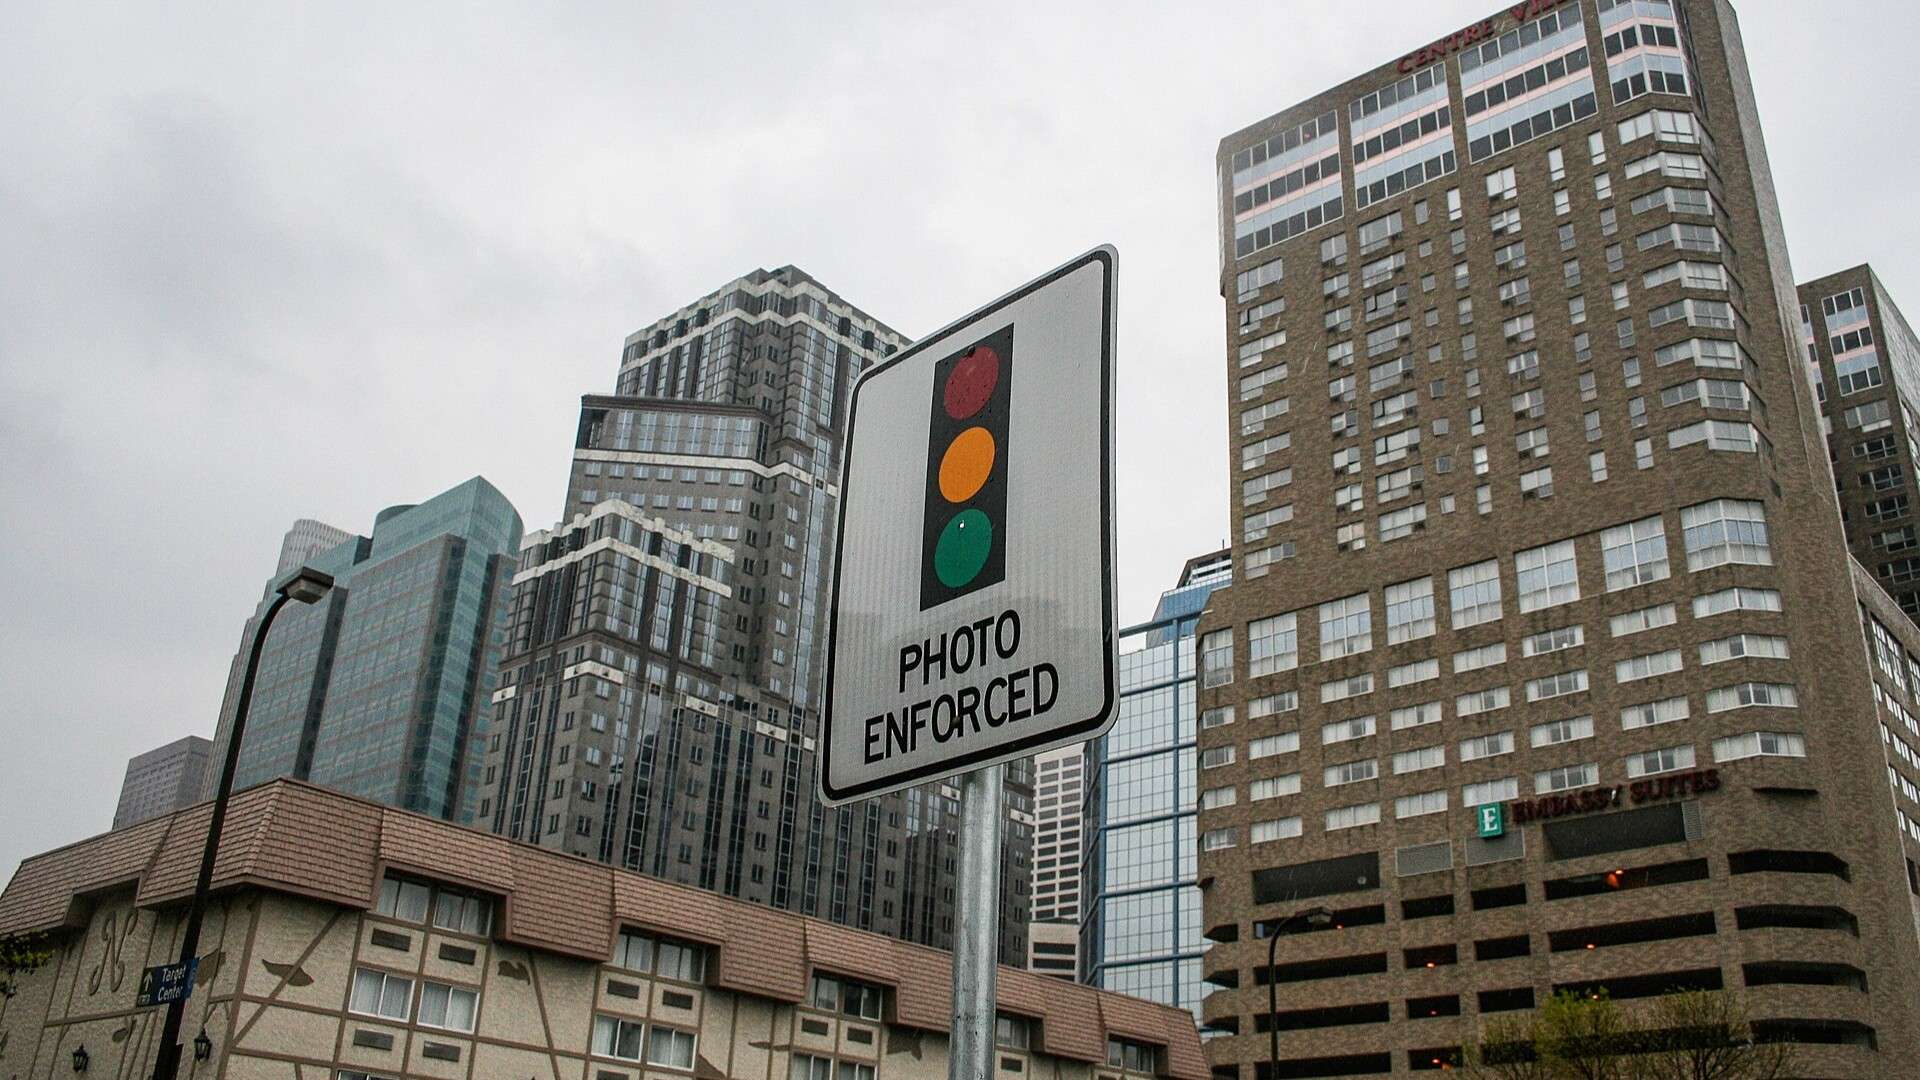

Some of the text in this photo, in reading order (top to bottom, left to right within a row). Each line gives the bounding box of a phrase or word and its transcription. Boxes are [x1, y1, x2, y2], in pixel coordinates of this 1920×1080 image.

[1397, 19, 1494, 73] CENTRE
[899, 609, 1021, 693] PHOTO
[864, 662, 1059, 765] ENFORCED
[1482, 807, 1499, 832] E
[1511, 768, 1722, 825] EMBASSY SUITES
[158, 985, 184, 1002] Center
[162, 964, 187, 985] Target
